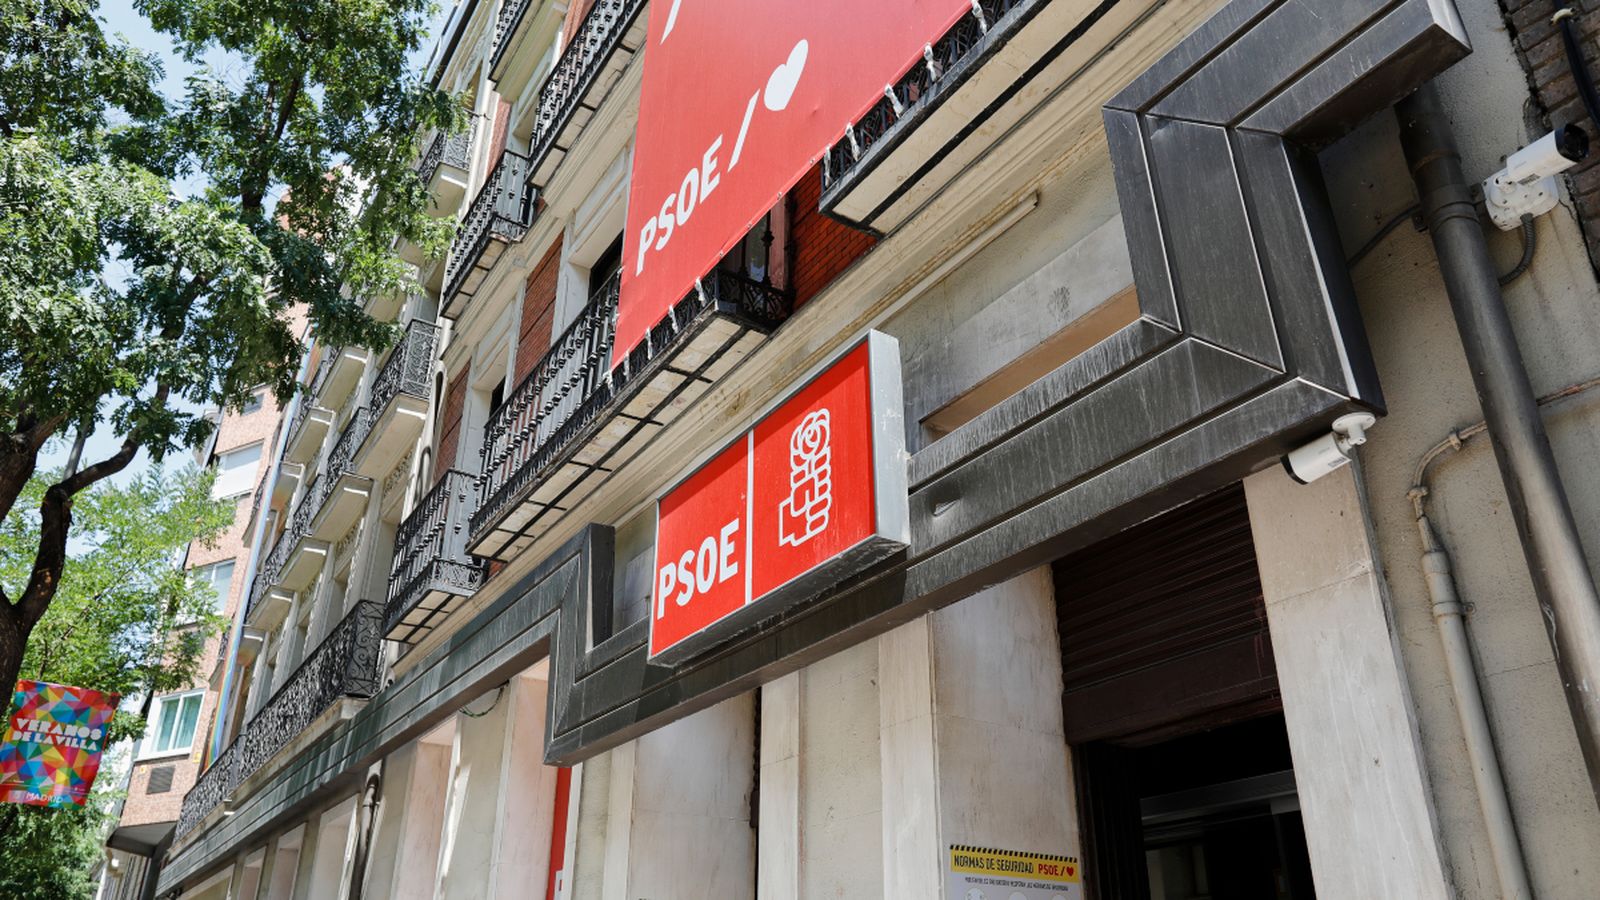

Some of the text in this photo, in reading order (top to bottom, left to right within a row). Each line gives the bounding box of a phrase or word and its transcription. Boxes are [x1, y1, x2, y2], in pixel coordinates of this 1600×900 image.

[636, 135, 723, 277] PSOE
[657, 518, 740, 620] PSOE
[17, 718, 103, 740] VERANOS
[12, 731, 33, 741] DE
[55, 735, 98, 751] VILLA
[25, 792, 64, 803] MADRID
[954, 855, 985, 869] NORMAS
[986, 858, 995, 870] DE
[996, 860, 1034, 874] SEGURIDAD
[1038, 863, 1059, 876] PSOE
